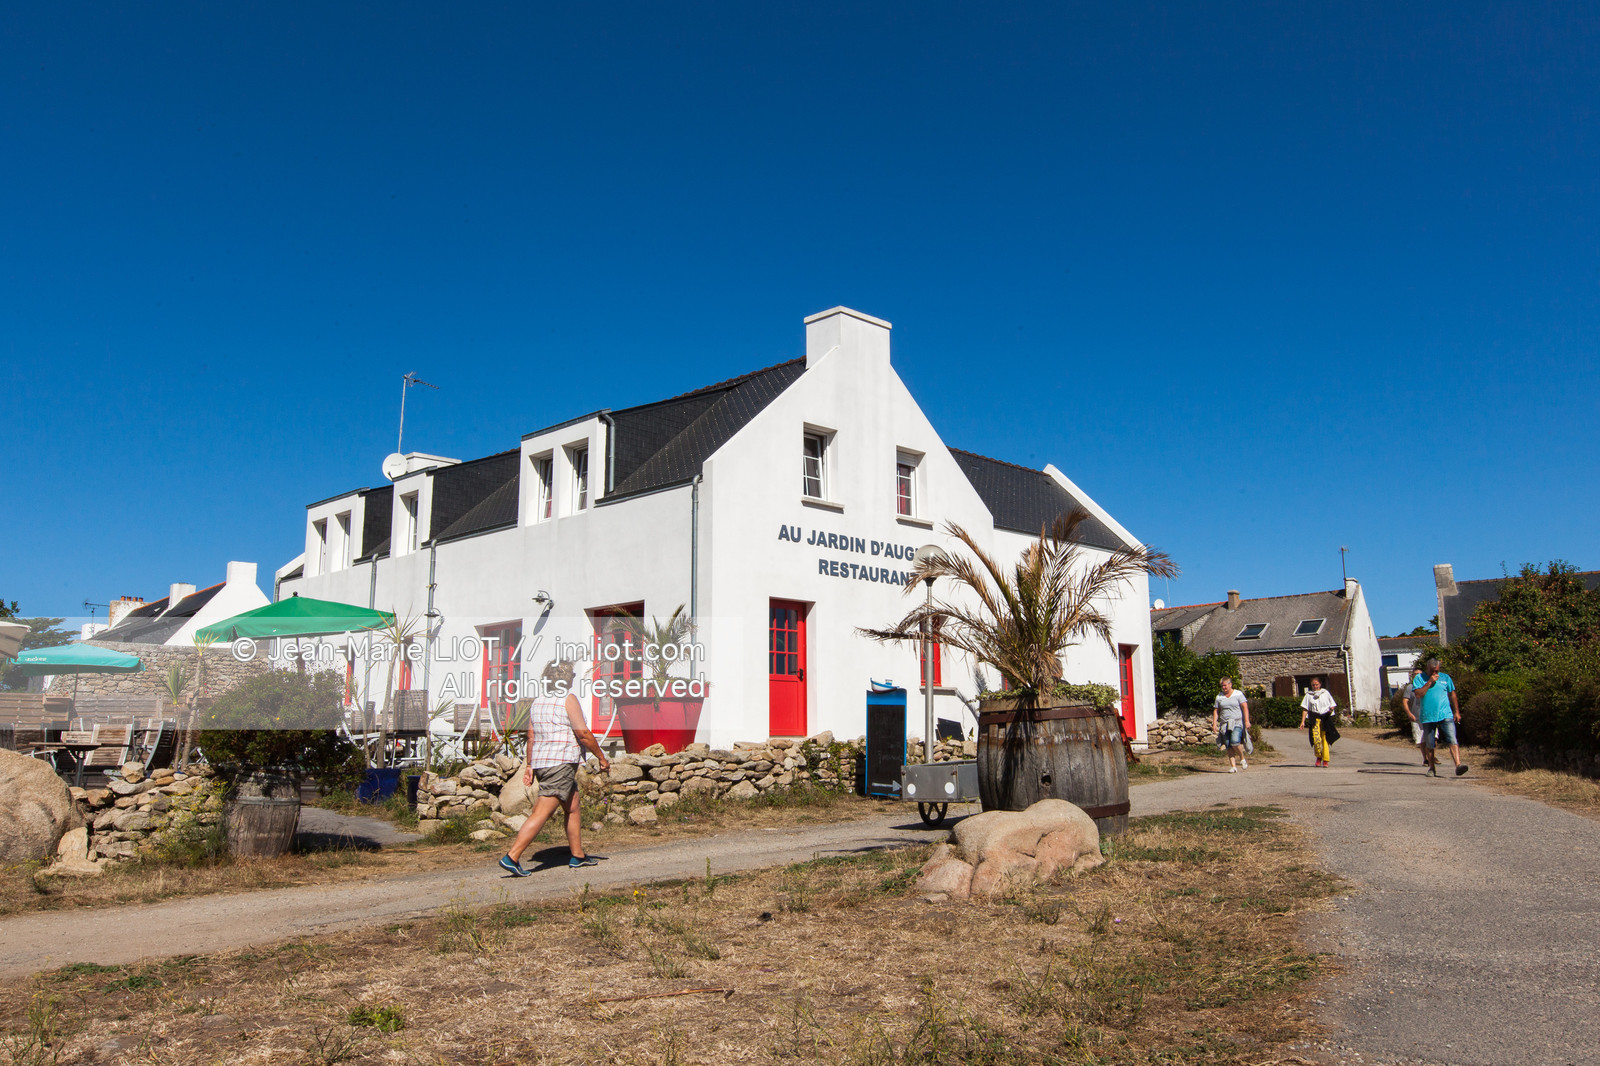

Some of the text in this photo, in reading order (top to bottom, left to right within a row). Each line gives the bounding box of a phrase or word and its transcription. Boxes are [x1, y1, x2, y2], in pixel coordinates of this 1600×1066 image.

[778, 524, 919, 562] AU JARDIN D'AUG
